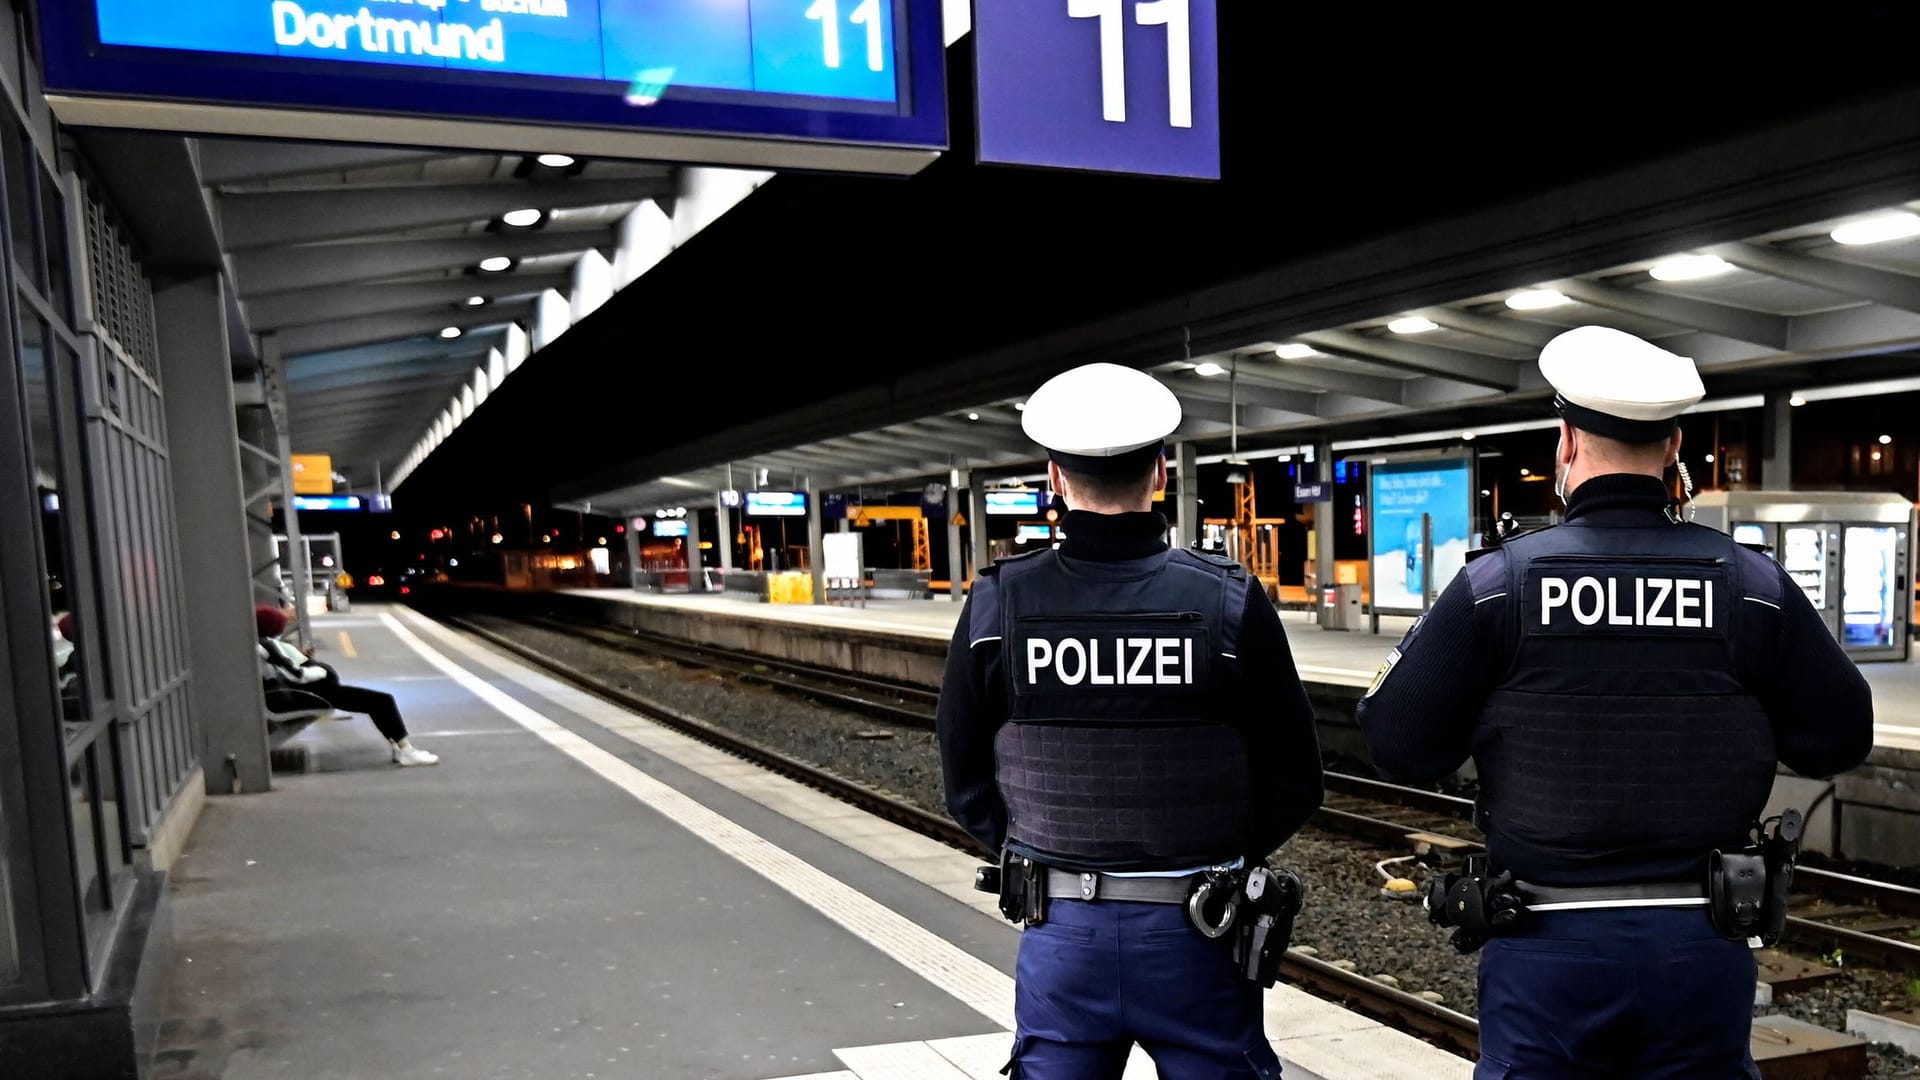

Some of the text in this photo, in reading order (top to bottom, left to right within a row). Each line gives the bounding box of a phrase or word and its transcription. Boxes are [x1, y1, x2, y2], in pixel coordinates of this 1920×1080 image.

[272, 0, 505, 61] Dortmund
[805, 0, 883, 72] 11
[1068, 0, 1192, 128] 11
[1541, 576, 1713, 629] POLIZEI
[1027, 637, 1192, 685] POLIZEI
